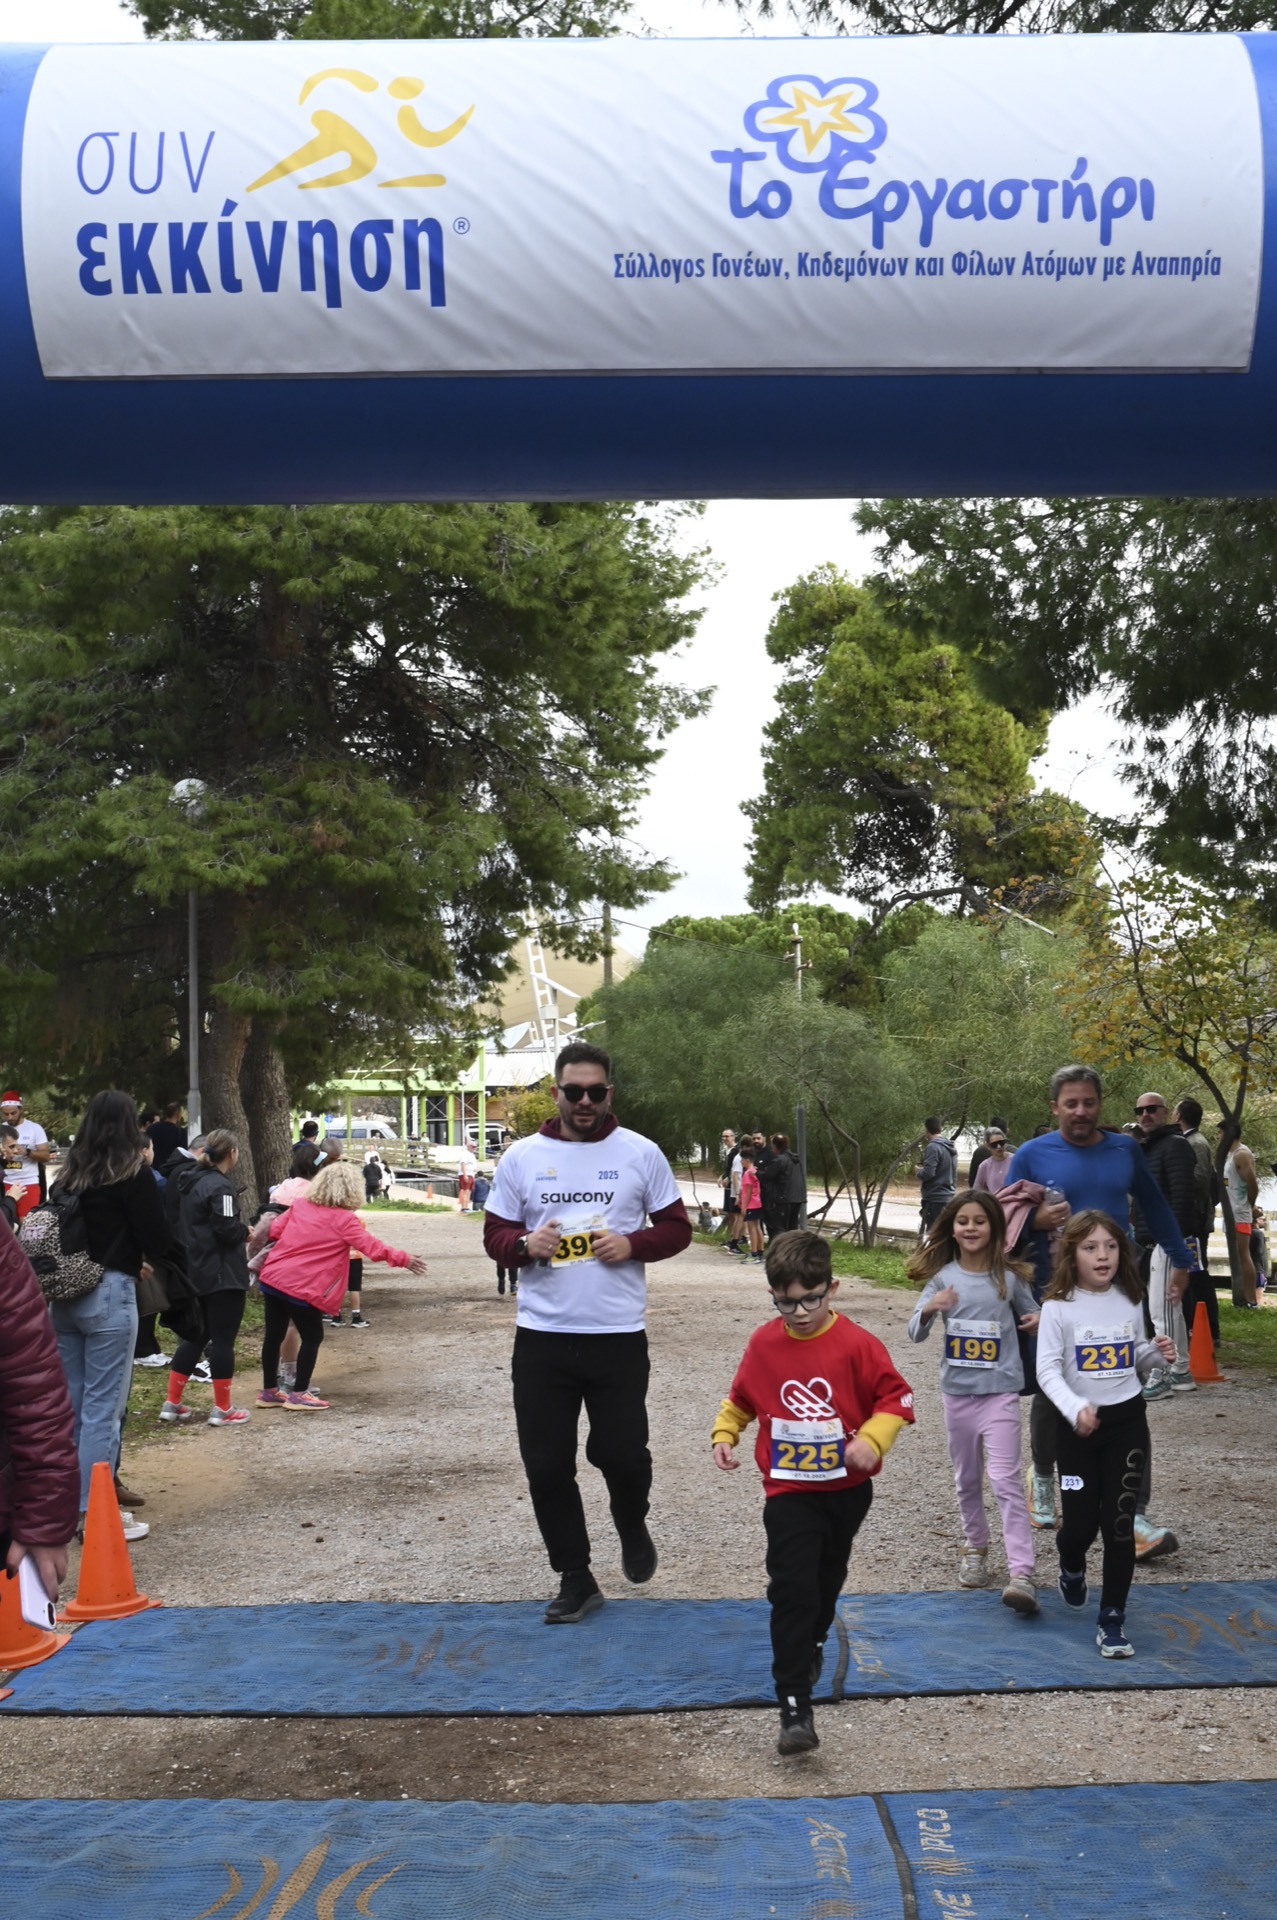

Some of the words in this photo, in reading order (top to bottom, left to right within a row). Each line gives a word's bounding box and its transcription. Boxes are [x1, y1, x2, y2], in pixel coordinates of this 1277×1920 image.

[76, 130, 216, 195] συν
[818, 148, 1156, 250] Εργαστήρι
[613, 252, 705, 284] Σύλλογος
[711, 251, 790, 280] Γονέων,
[797, 250, 909, 283] Κηδεμόνων
[915, 255, 944, 276] και
[951, 250, 1016, 277] Φίλων
[1021, 249, 1097, 282] Ατόμων
[1103, 256, 1126, 282] με
[1131, 249, 1222, 282] Αναπηρία
[598, 1170, 619, 1180] 2025
[540, 1191, 614, 1205] saucony
[949, 1337, 997, 1361] 199
[1081, 1344, 1130, 1370] 231
[777, 1442, 840, 1470] 225
[1065, 1478, 1080, 1487] 231
